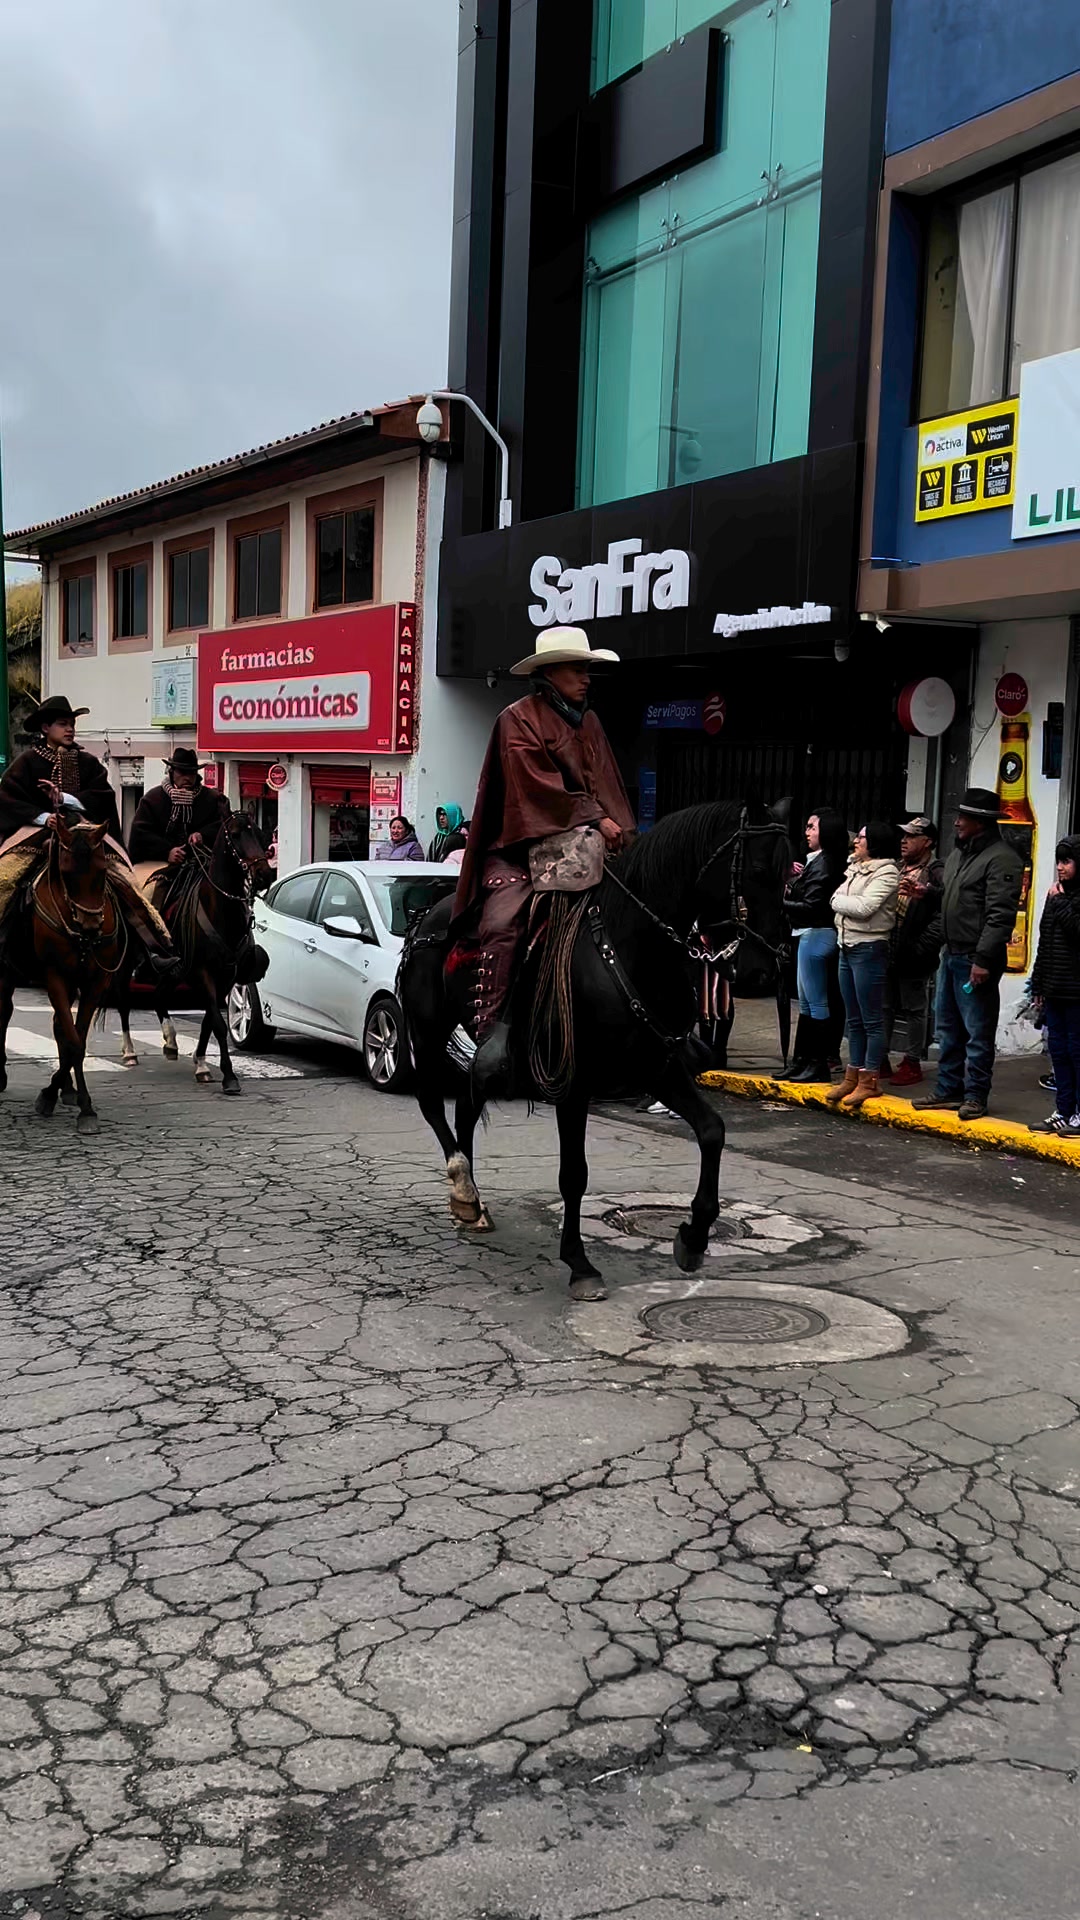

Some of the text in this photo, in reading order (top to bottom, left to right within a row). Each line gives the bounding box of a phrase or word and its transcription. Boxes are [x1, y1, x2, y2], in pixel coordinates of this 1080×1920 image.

[987, 423, 1010, 434] Western
[987, 432, 1004, 442] Union
[936, 438, 962, 452] activa
[528, 538, 690, 627] SanFra
[220, 641, 316, 673] farmacias
[398, 608, 414, 746] FARMACIA
[997, 688, 1022, 700] Claro
[219, 684, 360, 722] económicas
[646, 703, 697, 720] ServiPagos
